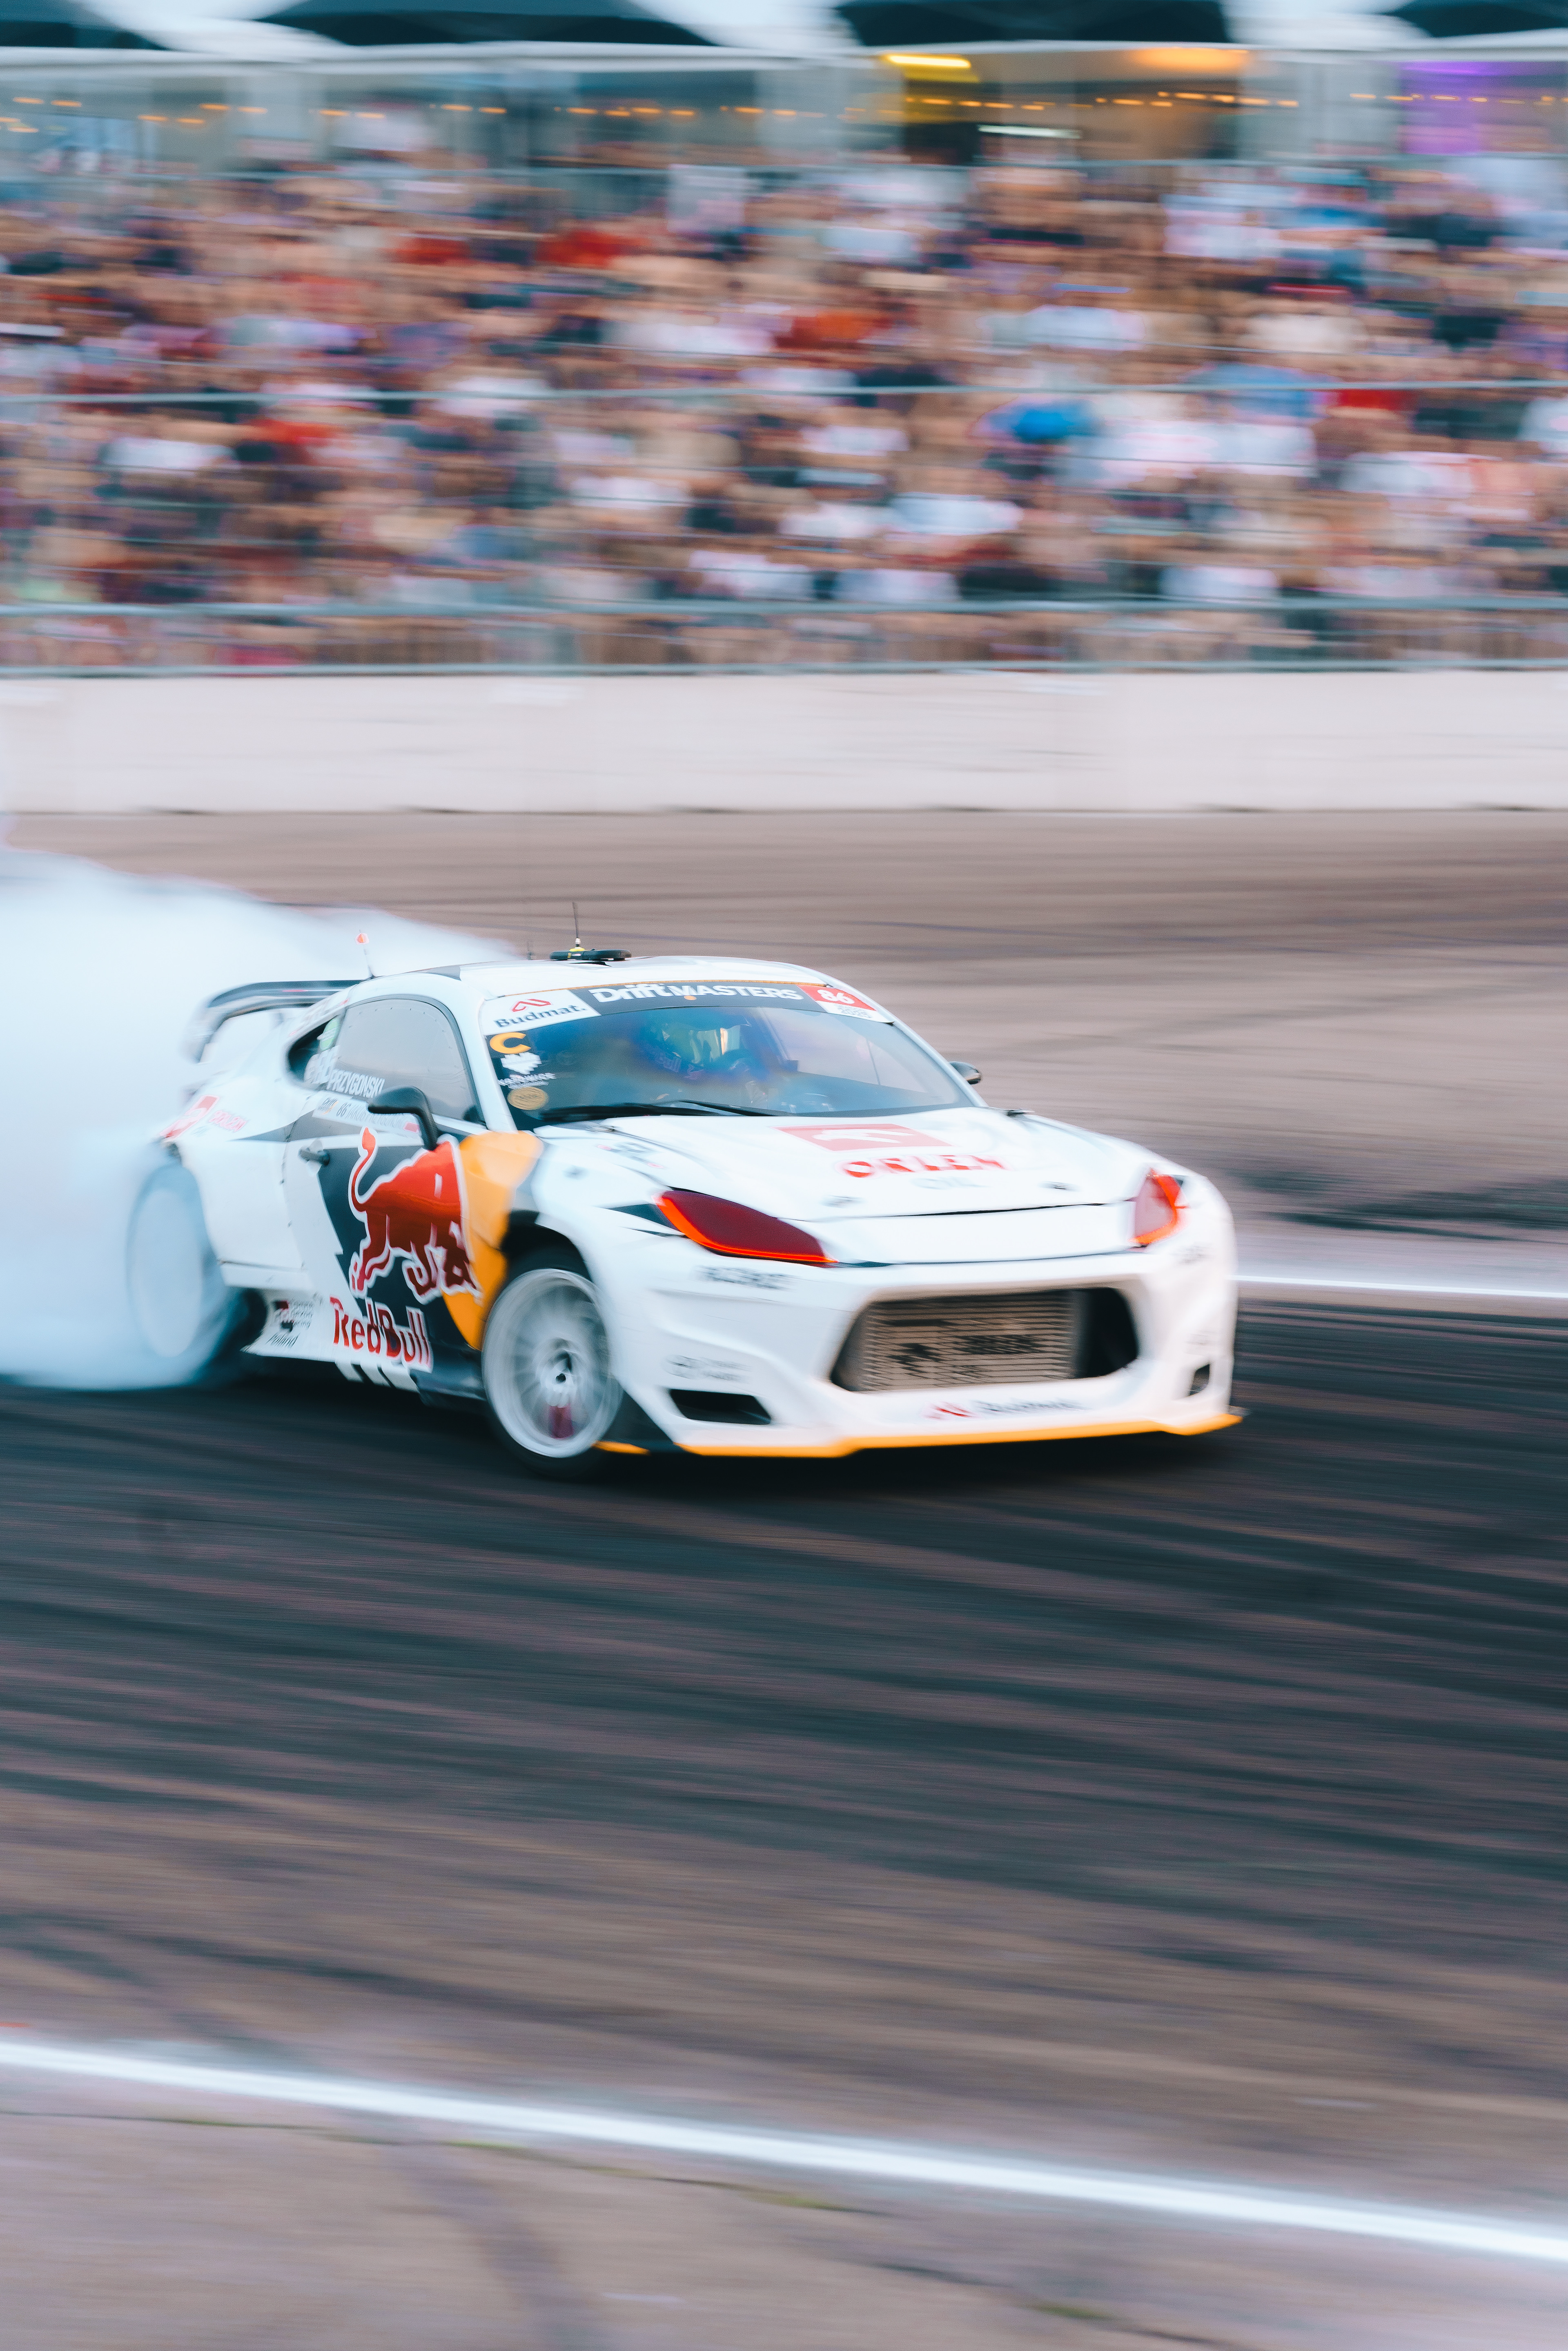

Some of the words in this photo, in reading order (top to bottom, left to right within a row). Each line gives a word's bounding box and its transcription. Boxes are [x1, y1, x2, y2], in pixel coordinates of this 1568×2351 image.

[817, 989, 855, 1004] 86
[490, 1032, 531, 1054] C
[336, 1103, 352, 1117] 86
[836, 1155, 1010, 1178] ORLEN
